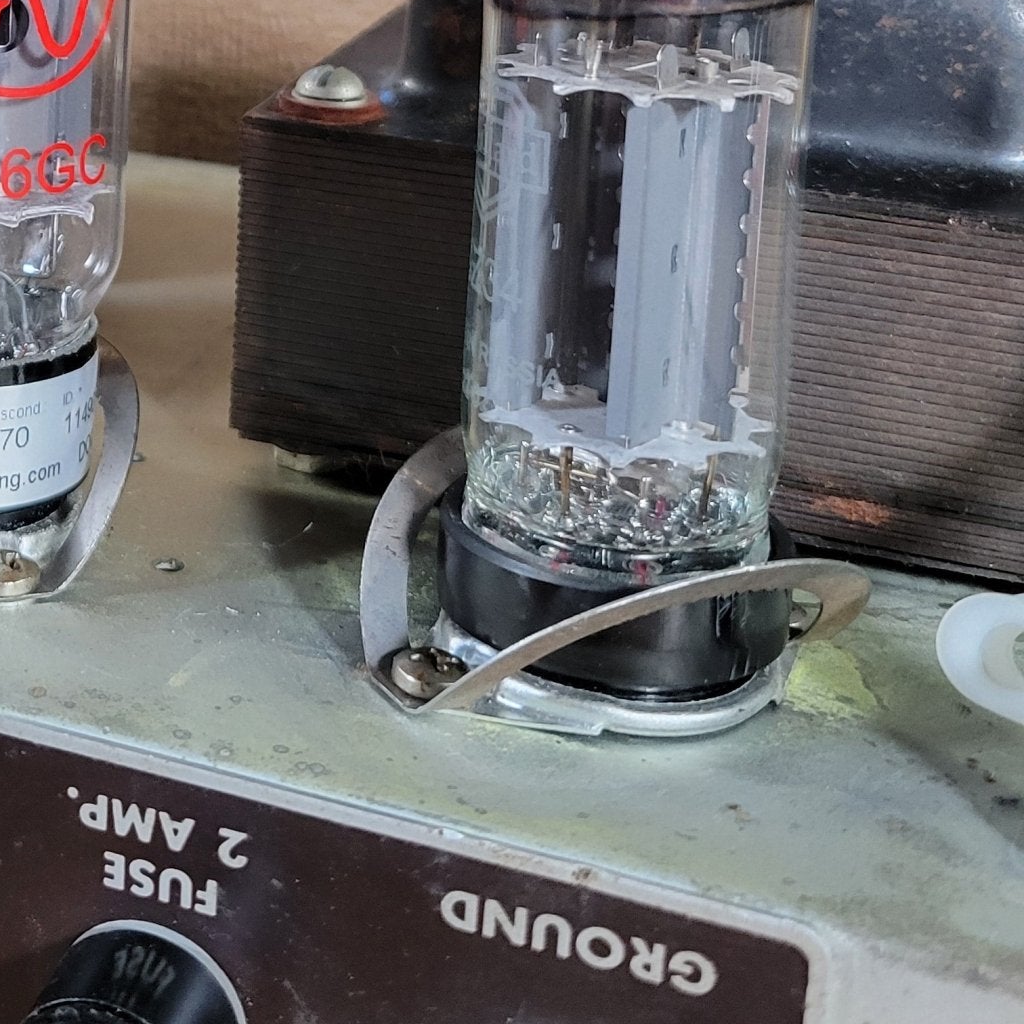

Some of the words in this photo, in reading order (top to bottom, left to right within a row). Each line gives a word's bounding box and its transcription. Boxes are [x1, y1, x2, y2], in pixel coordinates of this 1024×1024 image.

[67, 786, 196, 853] AMP.
[217, 827, 249, 869] 2
[102, 850, 219, 917] FUSE
[439, 889, 719, 997] GROUND
